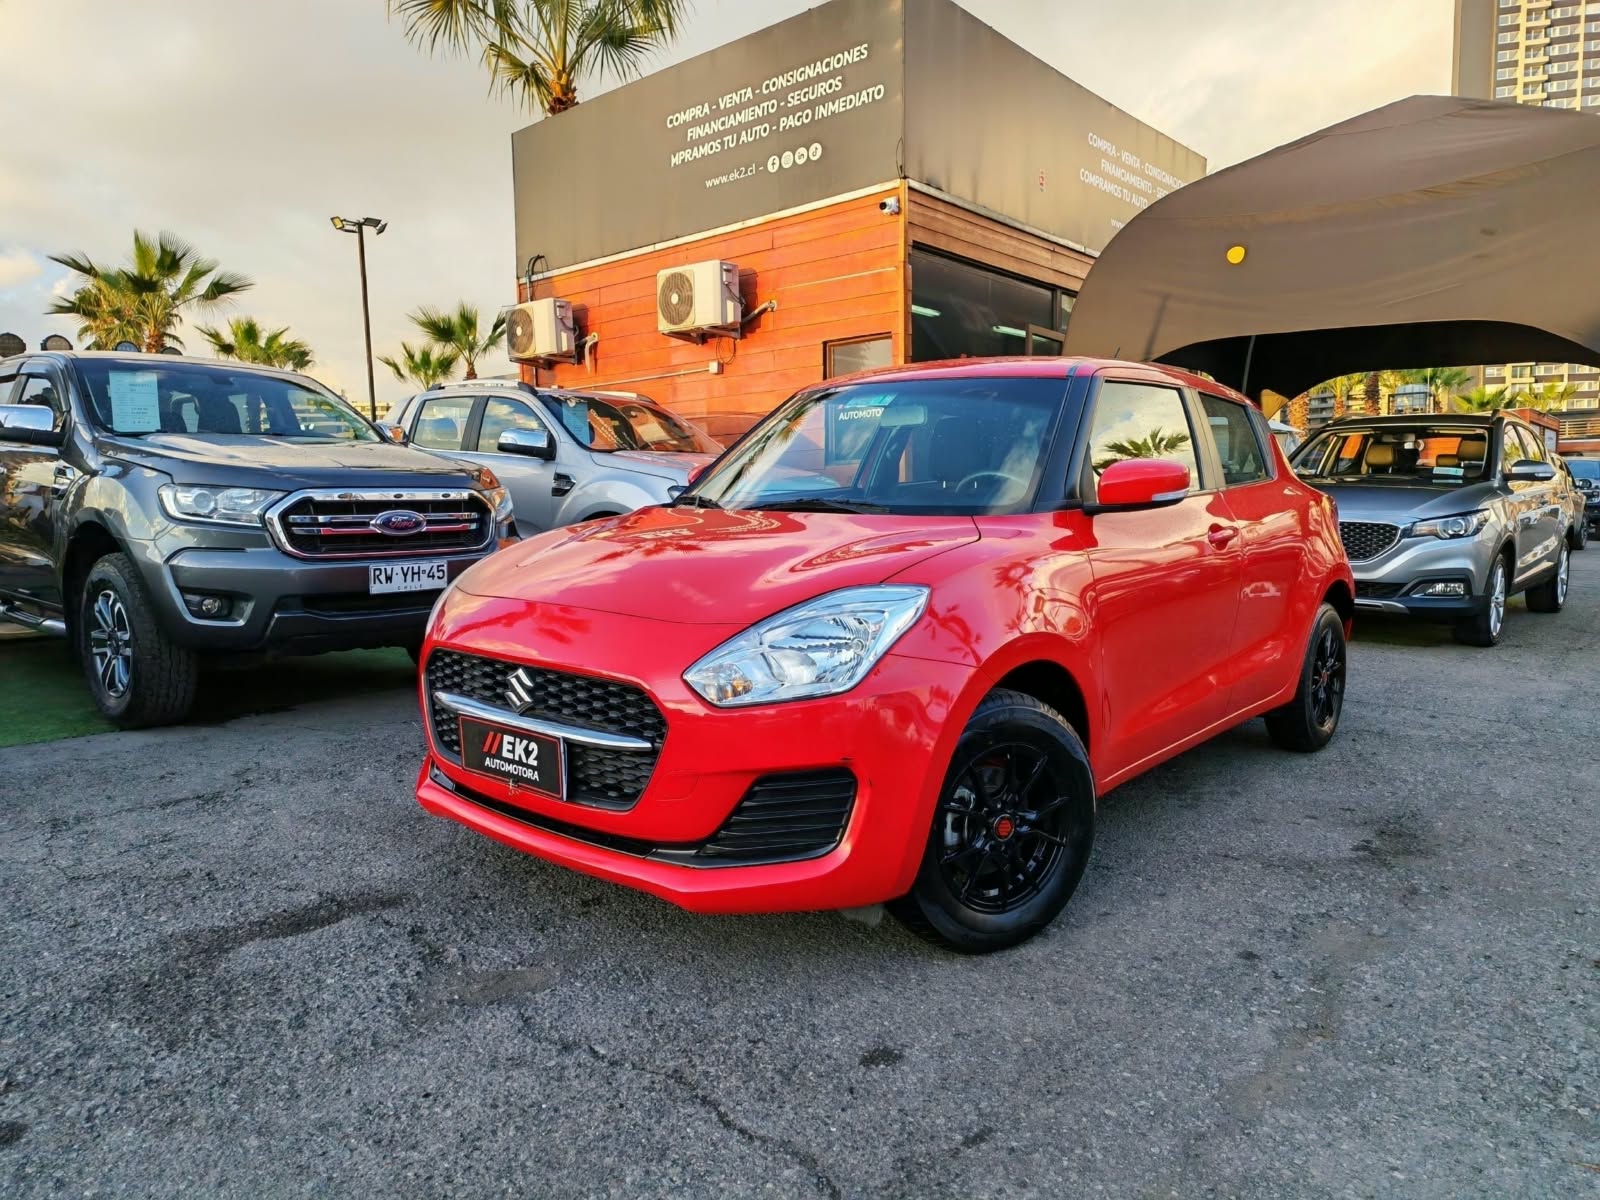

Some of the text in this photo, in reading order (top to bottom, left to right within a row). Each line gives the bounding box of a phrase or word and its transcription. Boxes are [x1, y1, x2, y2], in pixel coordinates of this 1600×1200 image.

[666, 102, 710, 128] COMPRA
[718, 86, 753, 110] VENTA
[762, 43, 868, 95] CONSIGNACIONES
[687, 99, 778, 142] FINANCIAMIENTO
[787, 75, 843, 108] SEGUROS
[722, 133, 737, 150] TU
[739, 123, 770, 145] AUTO
[779, 109, 812, 132] PAGO
[814, 84, 885, 121] INMEDIATO
[1087, 132, 1117, 158] COMPRA
[1121, 150, 1141, 170] VENTA
[705, 163, 756, 189] www.ek2.cl
[1080, 168, 1148, 209] COMPRAMOS TU AUTO
[1101, 158, 1152, 194] FINANCIAMIENTO
[838, 407, 885, 421] AUTOMOTO
[389, 515, 416, 529] Ford
[484, 756, 540, 782] AUTOMOTORA
